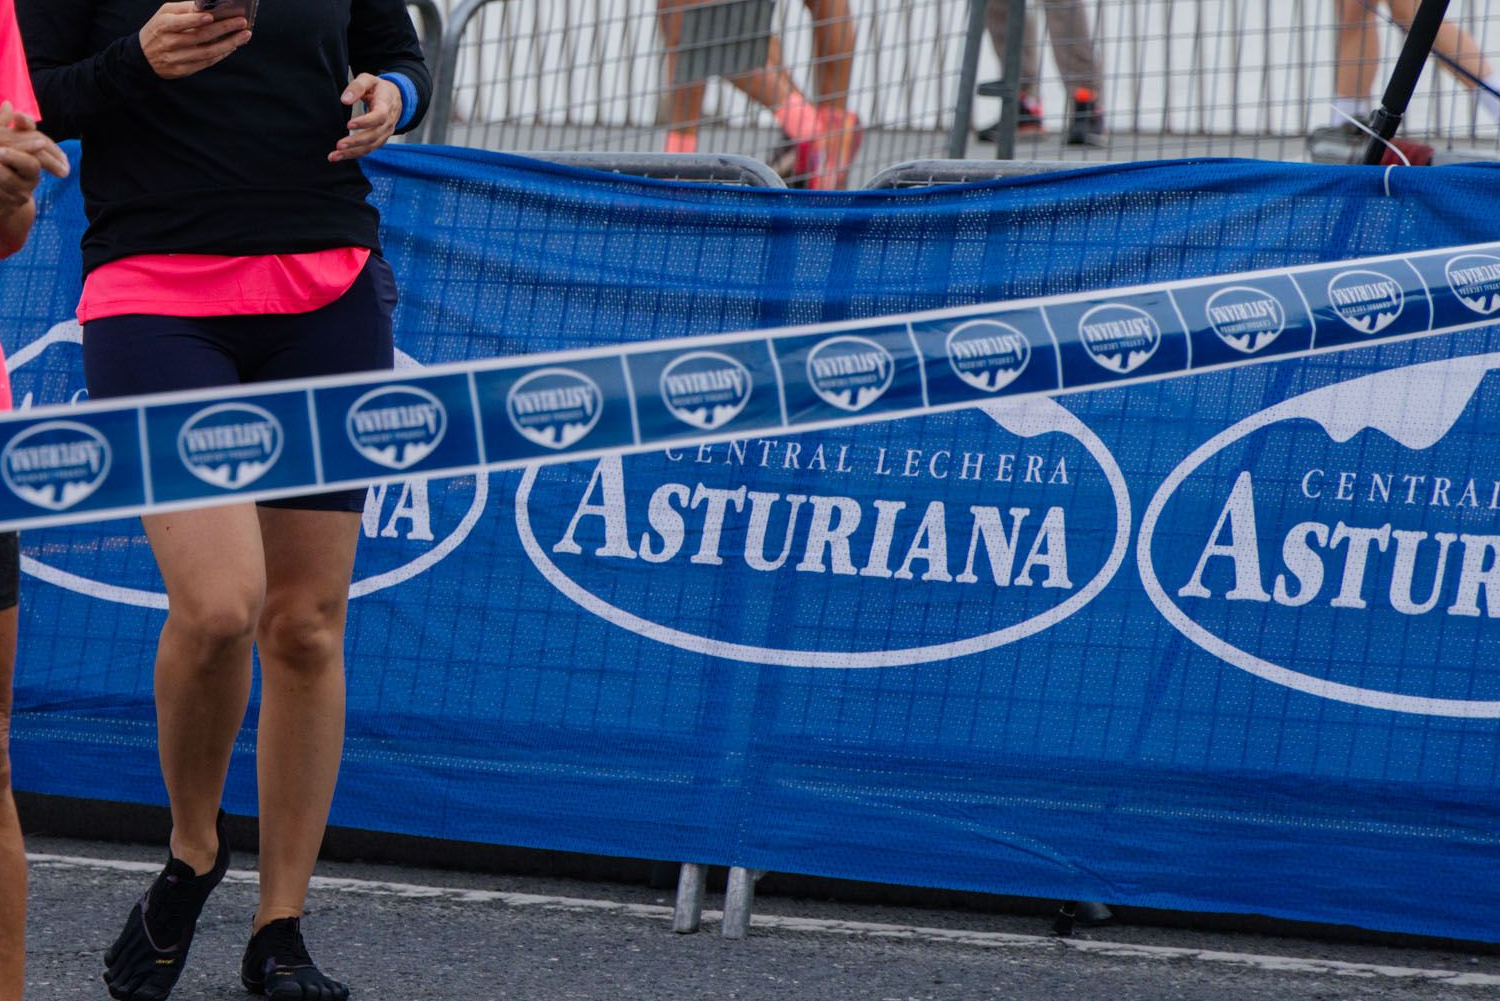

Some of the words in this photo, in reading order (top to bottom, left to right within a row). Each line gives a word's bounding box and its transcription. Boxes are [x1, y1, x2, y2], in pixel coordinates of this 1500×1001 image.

[1332, 280, 1397, 306] ASTURIANA
[1211, 299, 1278, 325] ASTURIANA
[1083, 317, 1153, 343] ASTURIANA
[951, 335, 1023, 361] ASTURIANA
[813, 352, 885, 379] ASTURIANA
[664, 438, 853, 473] CENTRAL
[874, 447, 1070, 485] LECHERA
[553, 455, 1074, 591] ASTURIANA
[1178, 470, 1500, 618] ASTUR
